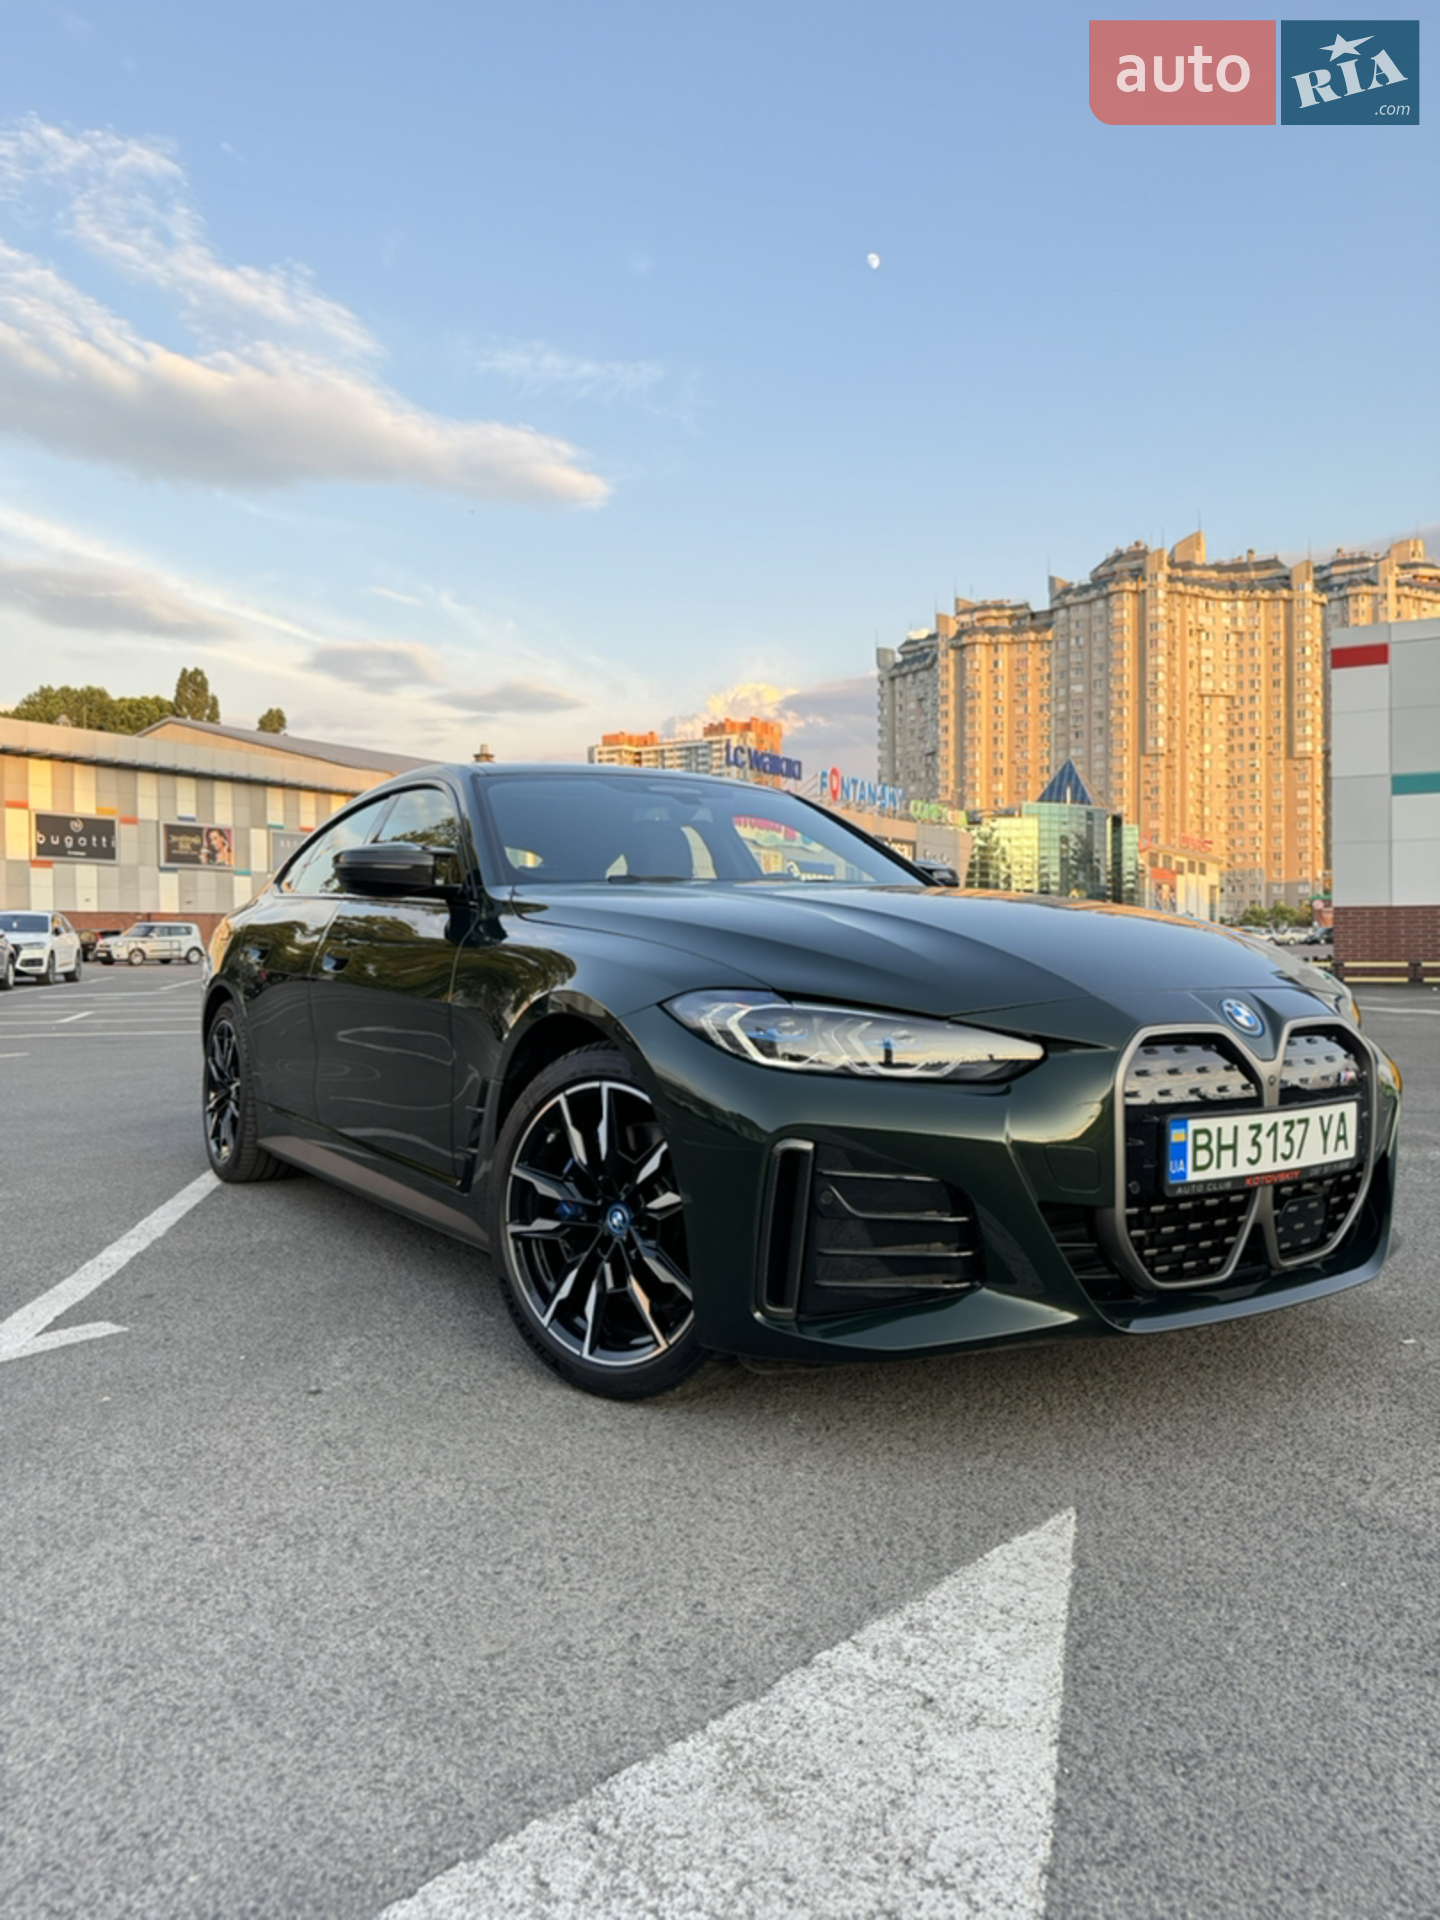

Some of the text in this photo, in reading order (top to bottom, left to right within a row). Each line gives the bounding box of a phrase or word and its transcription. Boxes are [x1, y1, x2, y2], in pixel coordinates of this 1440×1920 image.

[36, 829, 116, 849] bugatti
[1192, 1111, 1349, 1172] BH 3137 YA
[1169, 1159, 1186, 1174] UA
[1176, 1184, 1204, 1195] AUTO
